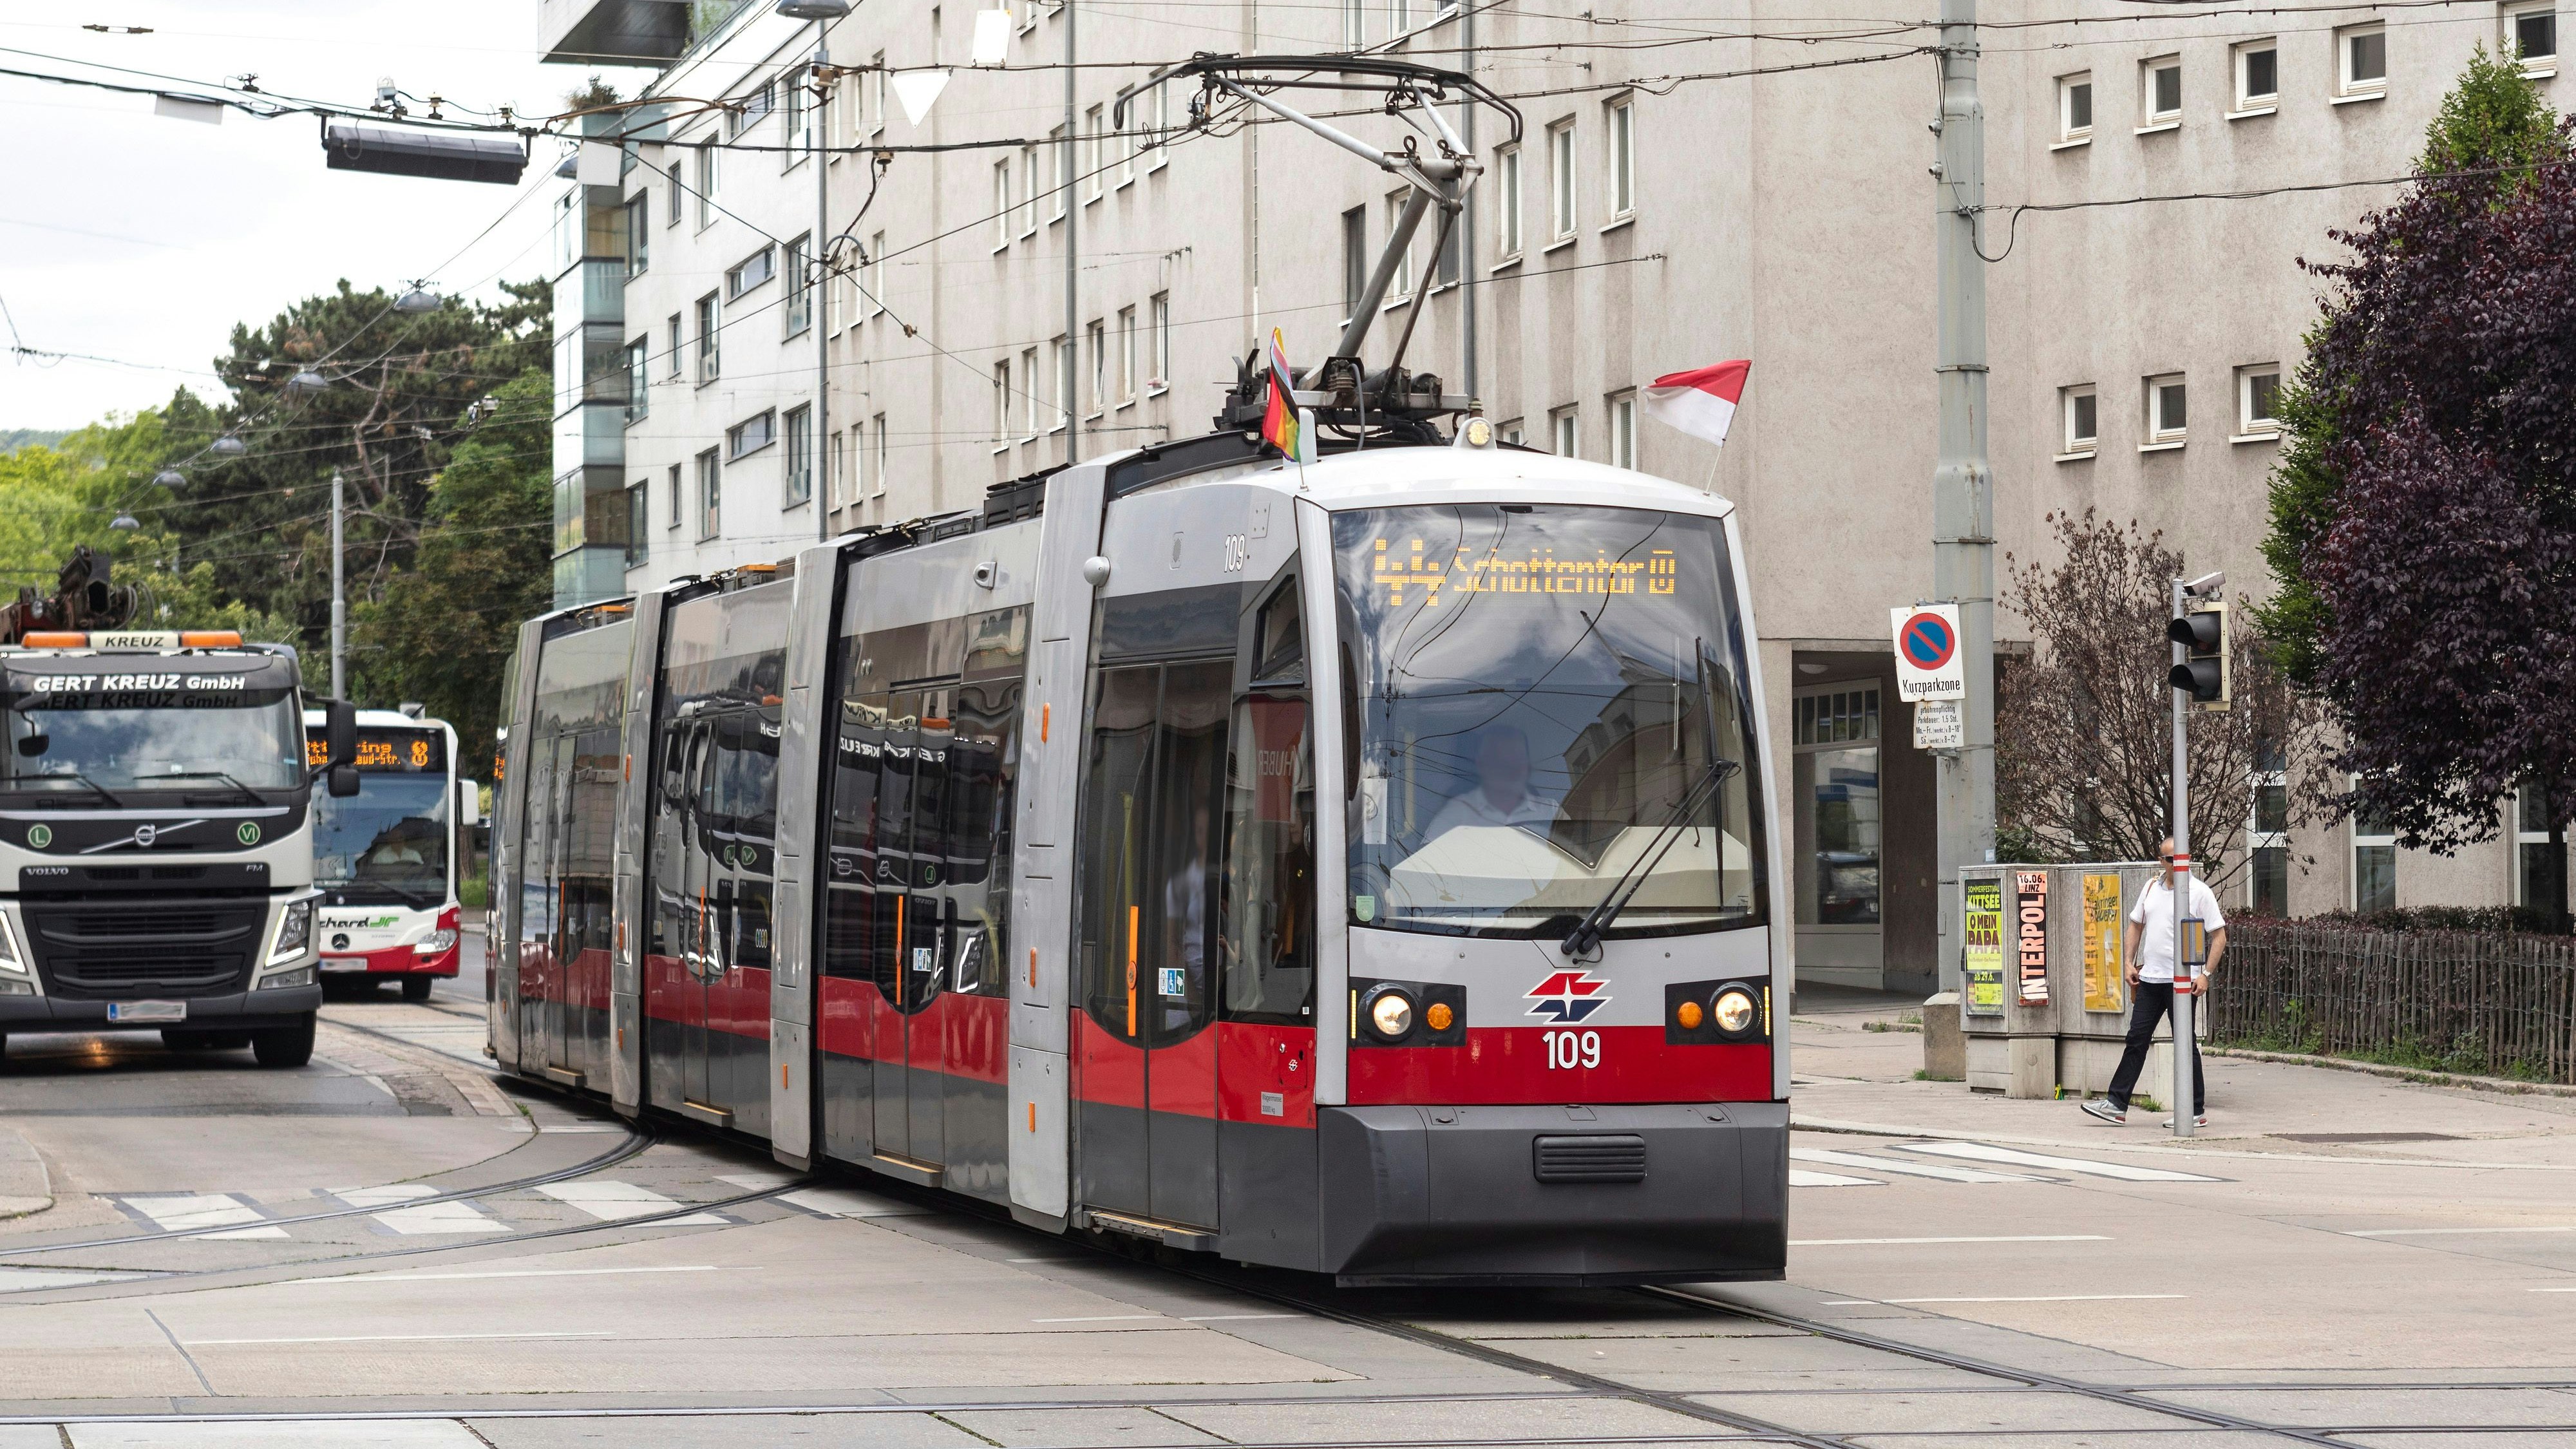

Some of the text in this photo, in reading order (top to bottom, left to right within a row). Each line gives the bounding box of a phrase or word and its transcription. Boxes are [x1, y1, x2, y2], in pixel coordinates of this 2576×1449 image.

[1224, 534, 1245, 572] 109
[1375, 538, 1446, 606] 44
[1454, 547, 1645, 594] Schottentor
[105, 636, 165, 647] KREUZ
[33, 674, 245, 692] GERT KREUZ GmbH
[1903, 677, 1960, 696] Kurzparkzone
[41, 692, 95, 709] ERT
[1920, 705, 1955, 715] gebührenpflichtig
[35, 827, 255, 843] L VI
[2020, 875, 2045, 884] 16.06.
[2025, 884, 2040, 893] LINZ
[1968, 894, 2000, 909] KITTSEE
[1970, 914, 1996, 929] O MEIN
[1968, 930, 2001, 954] PAPA
[2020, 895, 2049, 1000] INTERPOL
[1975, 971, 1994, 981] ab 29.6.
[1542, 1031, 1601, 1069] 109
